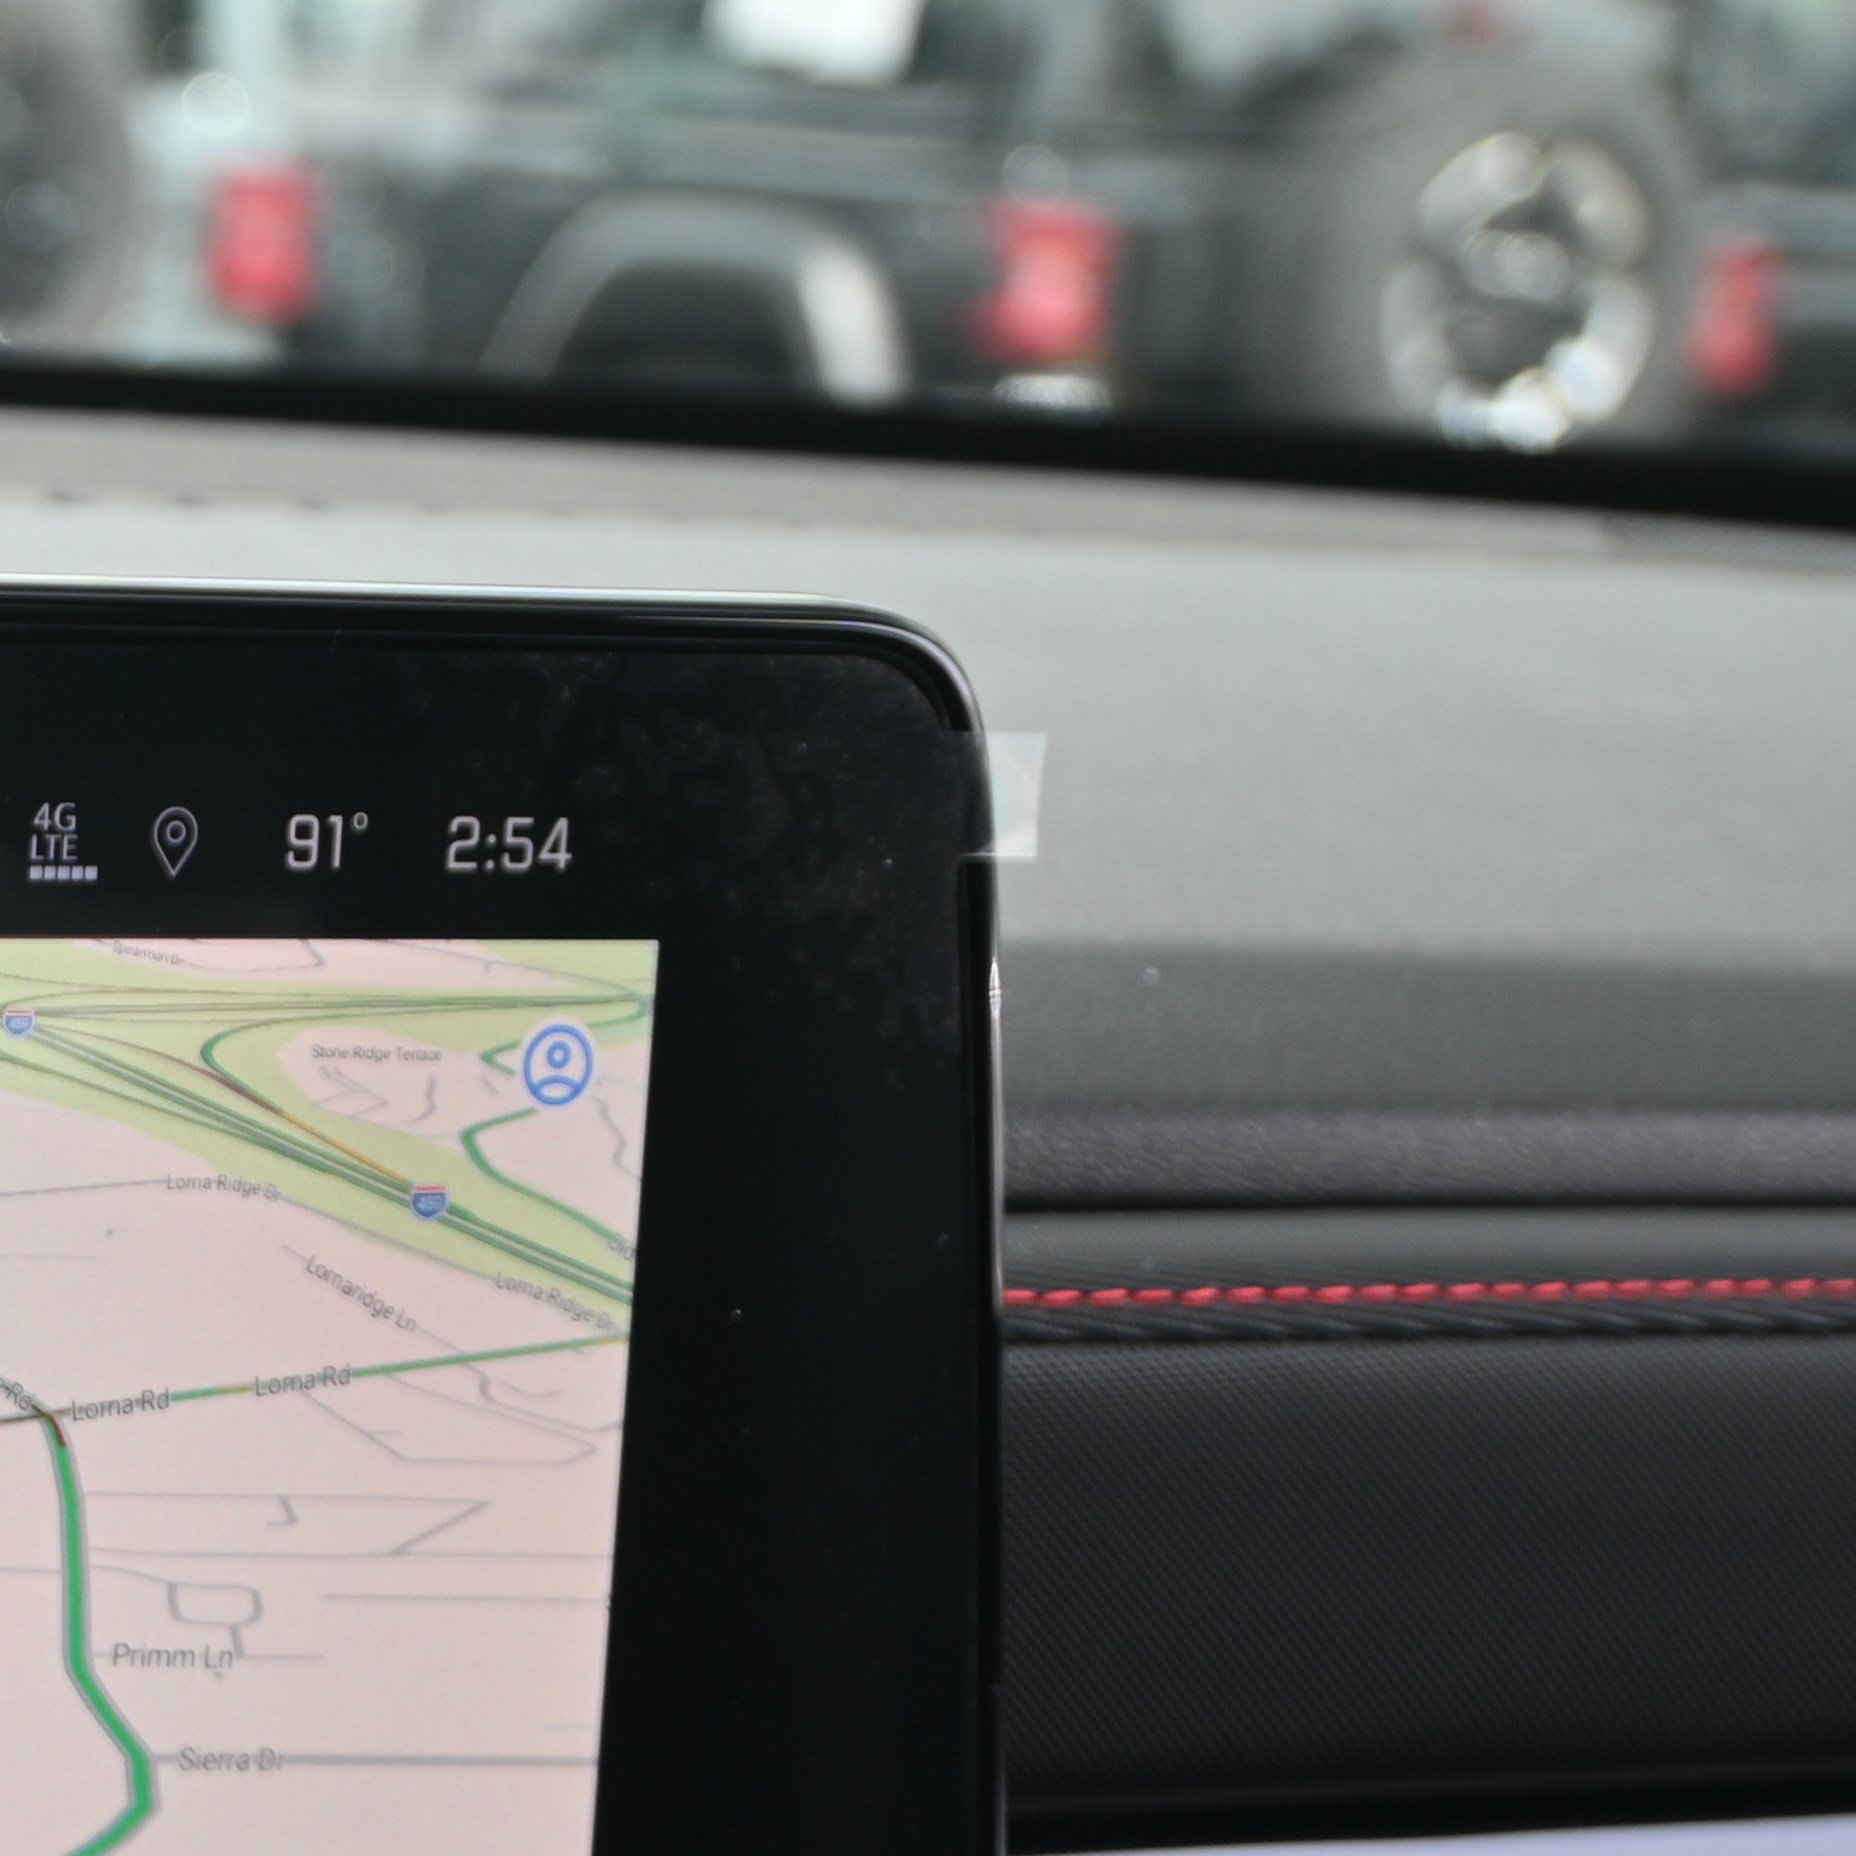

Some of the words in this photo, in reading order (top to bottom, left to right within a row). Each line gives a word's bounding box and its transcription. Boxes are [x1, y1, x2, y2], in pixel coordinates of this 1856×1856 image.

[32, 802, 77, 832] 4G
[29, 834, 78, 861] LTE
[286, 812, 369, 871] 91°
[445, 815, 574, 872] 2:54
[312, 1043, 349, 1059] Stone
[353, 1044, 391, 1061] Ridge
[216, 1173, 261, 1198] Ridge
[548, 1287, 594, 1322] Ridge
[391, 1308, 417, 1334] Ln
[322, 1362, 352, 1387] Rd
[6, 1383, 37, 1411] Rd
[140, 1386, 171, 1412] Rd
[111, 1641, 196, 1668] Primm
[202, 1643, 236, 1669] Ln
[177, 1745, 251, 1774] Sierra
[257, 1746, 288, 1774] Dr
